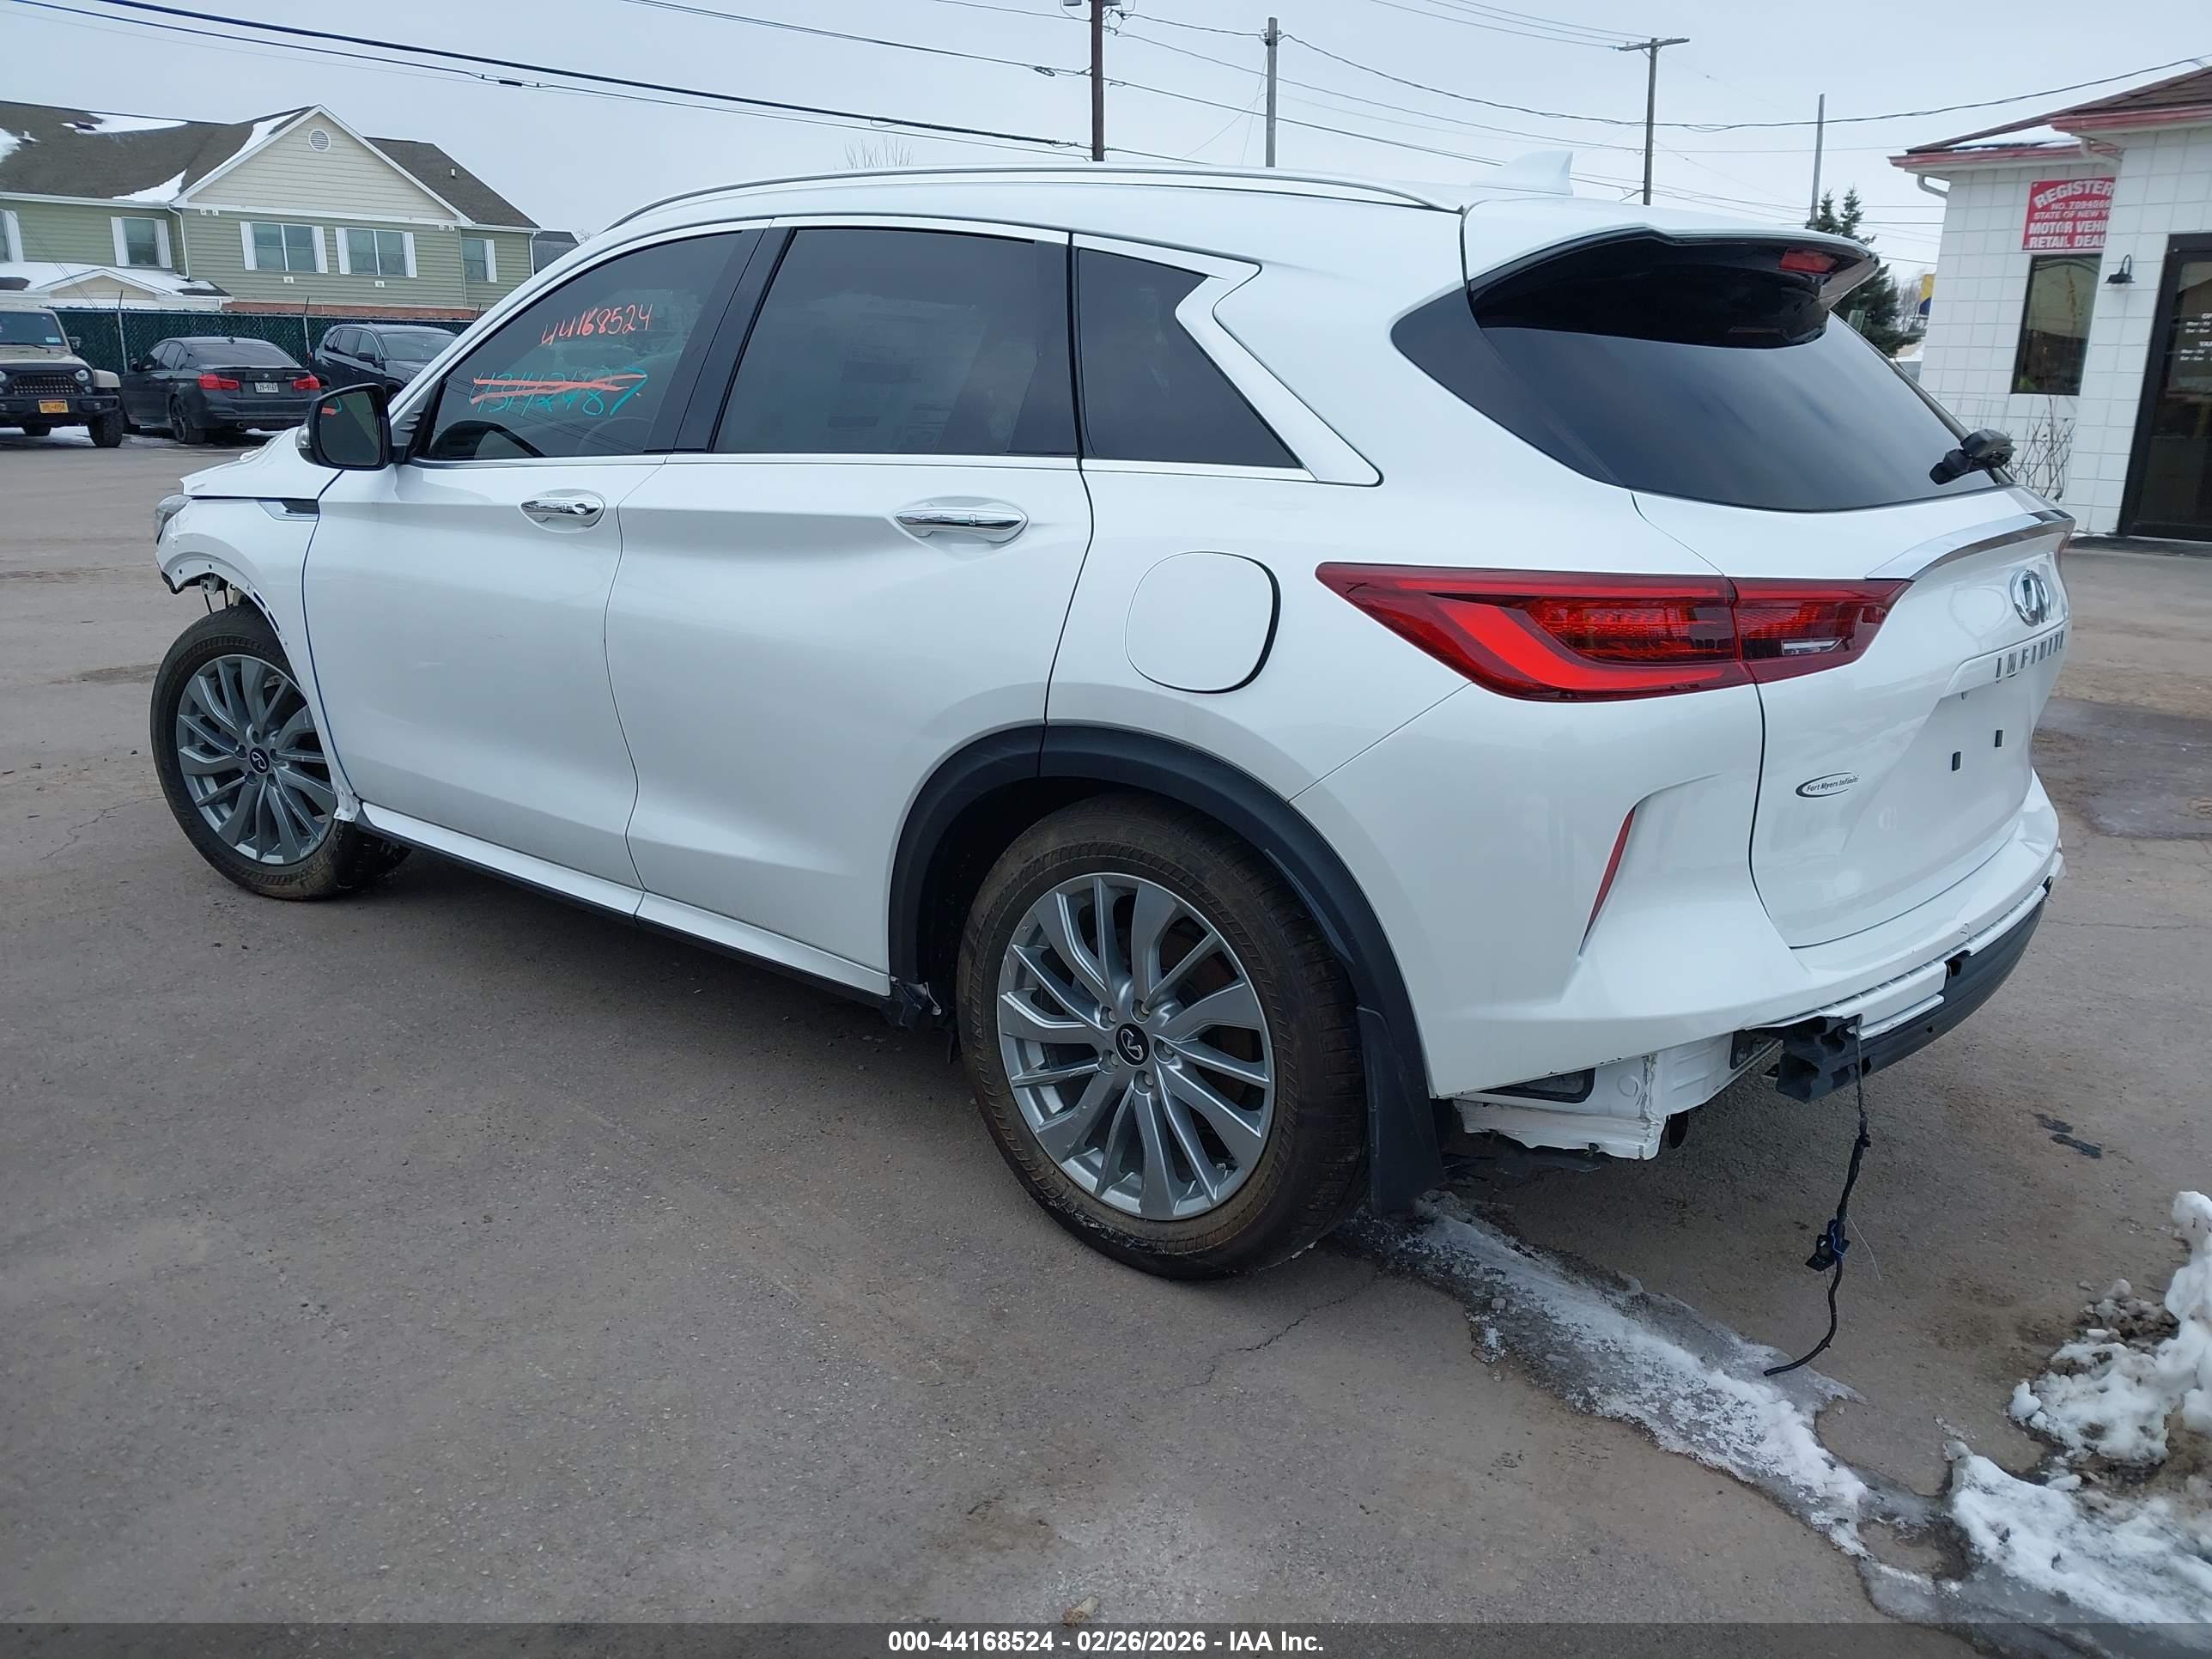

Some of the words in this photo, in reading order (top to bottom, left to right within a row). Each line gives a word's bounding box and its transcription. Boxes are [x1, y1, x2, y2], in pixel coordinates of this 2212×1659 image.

[2033, 211, 2061, 220] STATE
[2063, 210, 2076, 219] OF
[2077, 209, 2101, 218] NEW
[2028, 222, 2074, 234] MOTOR
[2029, 236, 2071, 248] RETAIL
[541, 303, 653, 345] 44168524
[1996, 630, 2064, 678] INFINITI
[1807, 783, 1820, 793] Fort
[1820, 781, 1838, 791] Myers
[1838, 775, 1859, 786] Infiniti
